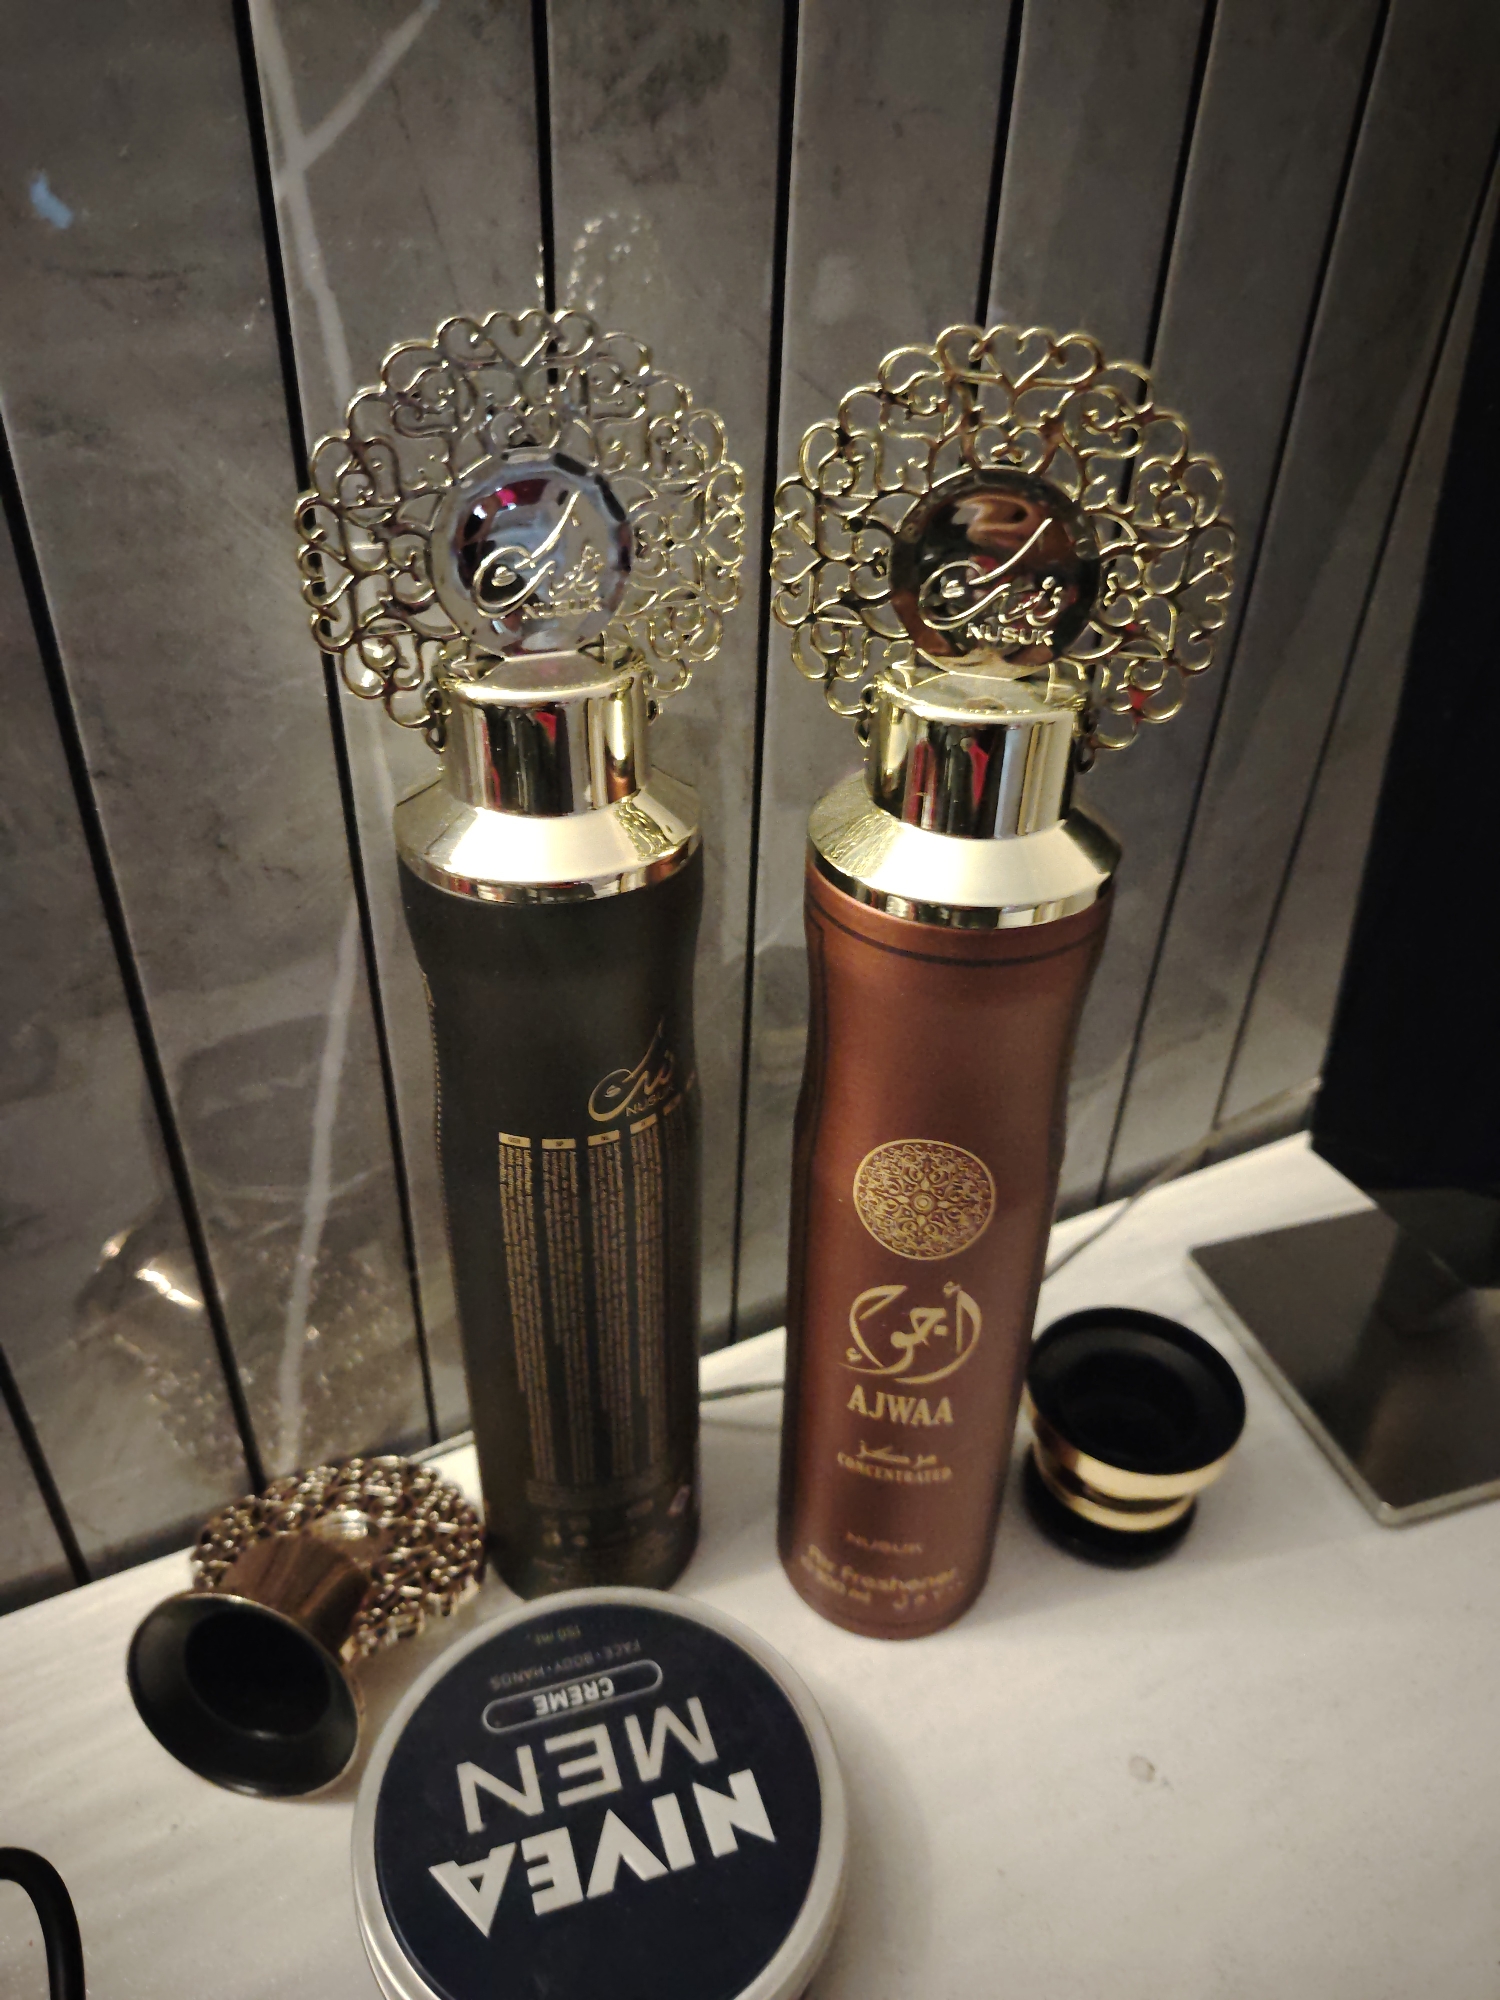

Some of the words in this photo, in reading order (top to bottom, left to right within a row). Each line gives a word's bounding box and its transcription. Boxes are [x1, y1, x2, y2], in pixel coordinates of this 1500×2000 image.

[966, 621, 1055, 647] NUSUK
[847, 1384, 954, 1428] AJWAA
[532, 1677, 615, 1717] CREME
[456, 1696, 719, 1834] MEN
[428, 1768, 777, 1939] NIVEA
